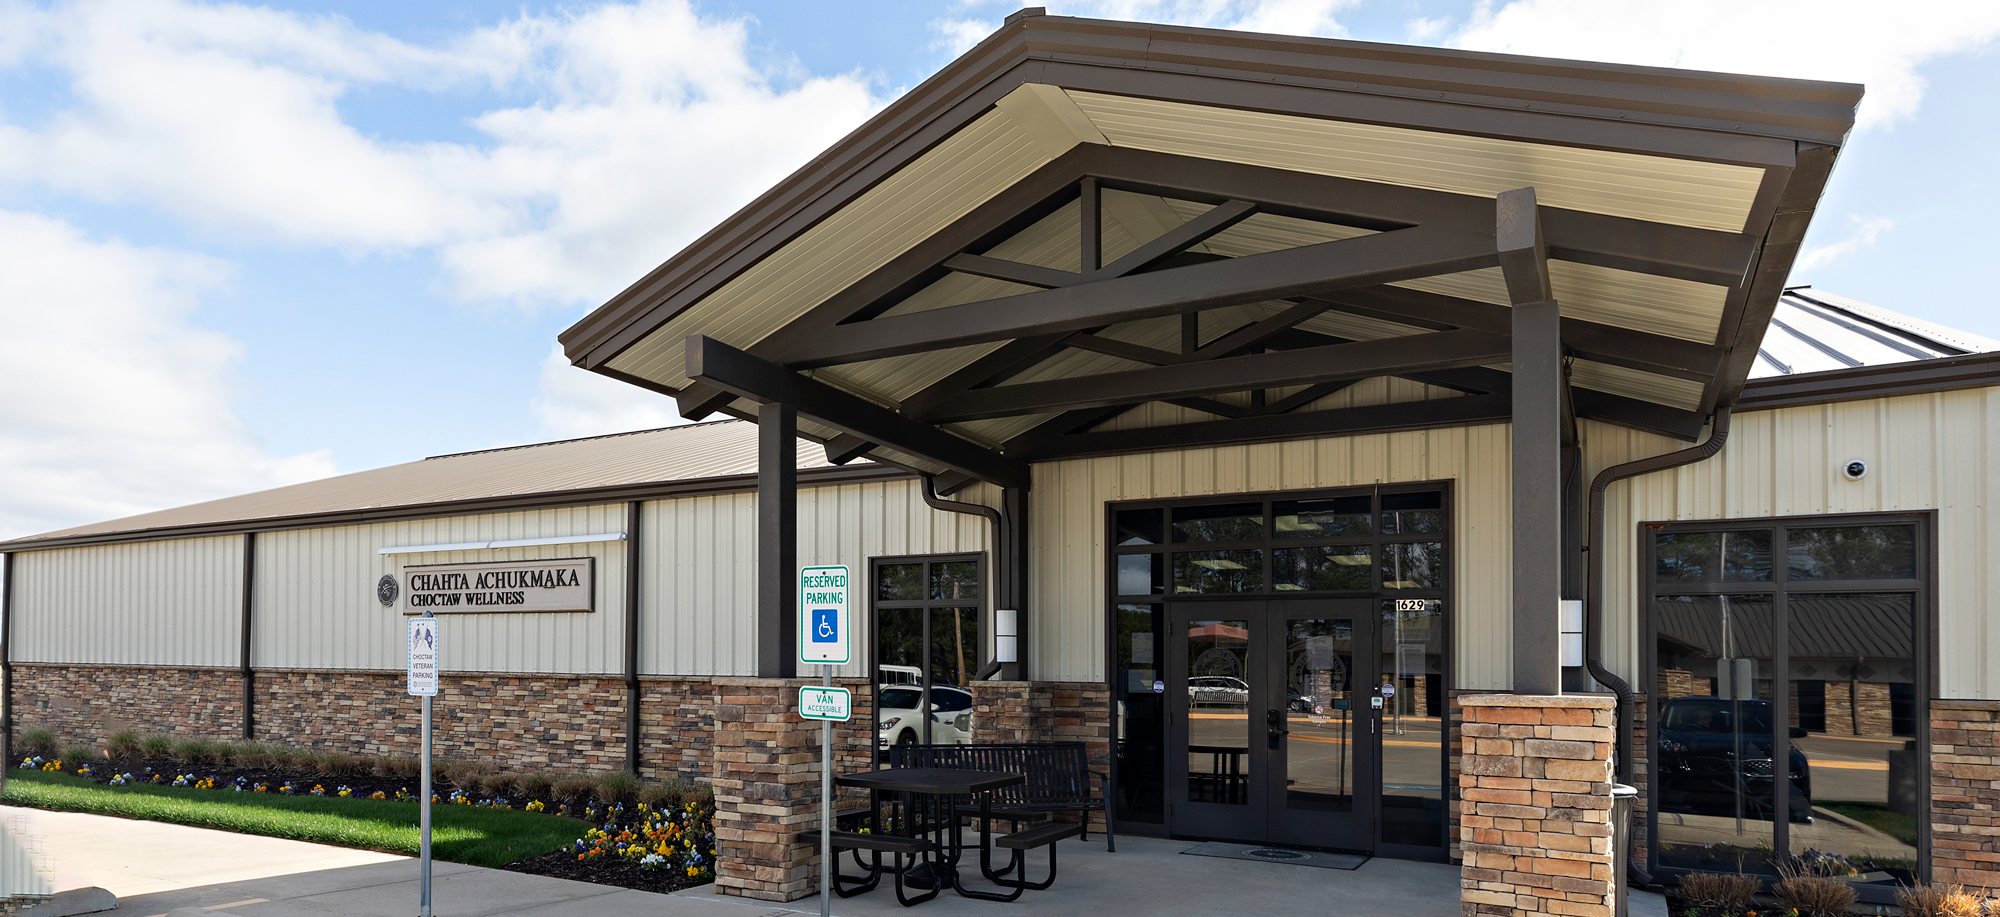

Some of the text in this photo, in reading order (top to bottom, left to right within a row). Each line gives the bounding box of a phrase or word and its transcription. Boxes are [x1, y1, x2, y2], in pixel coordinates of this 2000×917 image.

[411, 573, 470, 591] CHAHTA
[475, 568, 580, 589] ACHUKMAKA
[804, 575, 846, 588] RESERVED
[411, 591, 525, 607] CHOCTAW WELLNESS
[806, 592, 843, 605] PARKING
[1396, 600, 1424, 610] 1629
[816, 694, 834, 704] VAN
[807, 704, 842, 714] ACCESSIBLE
